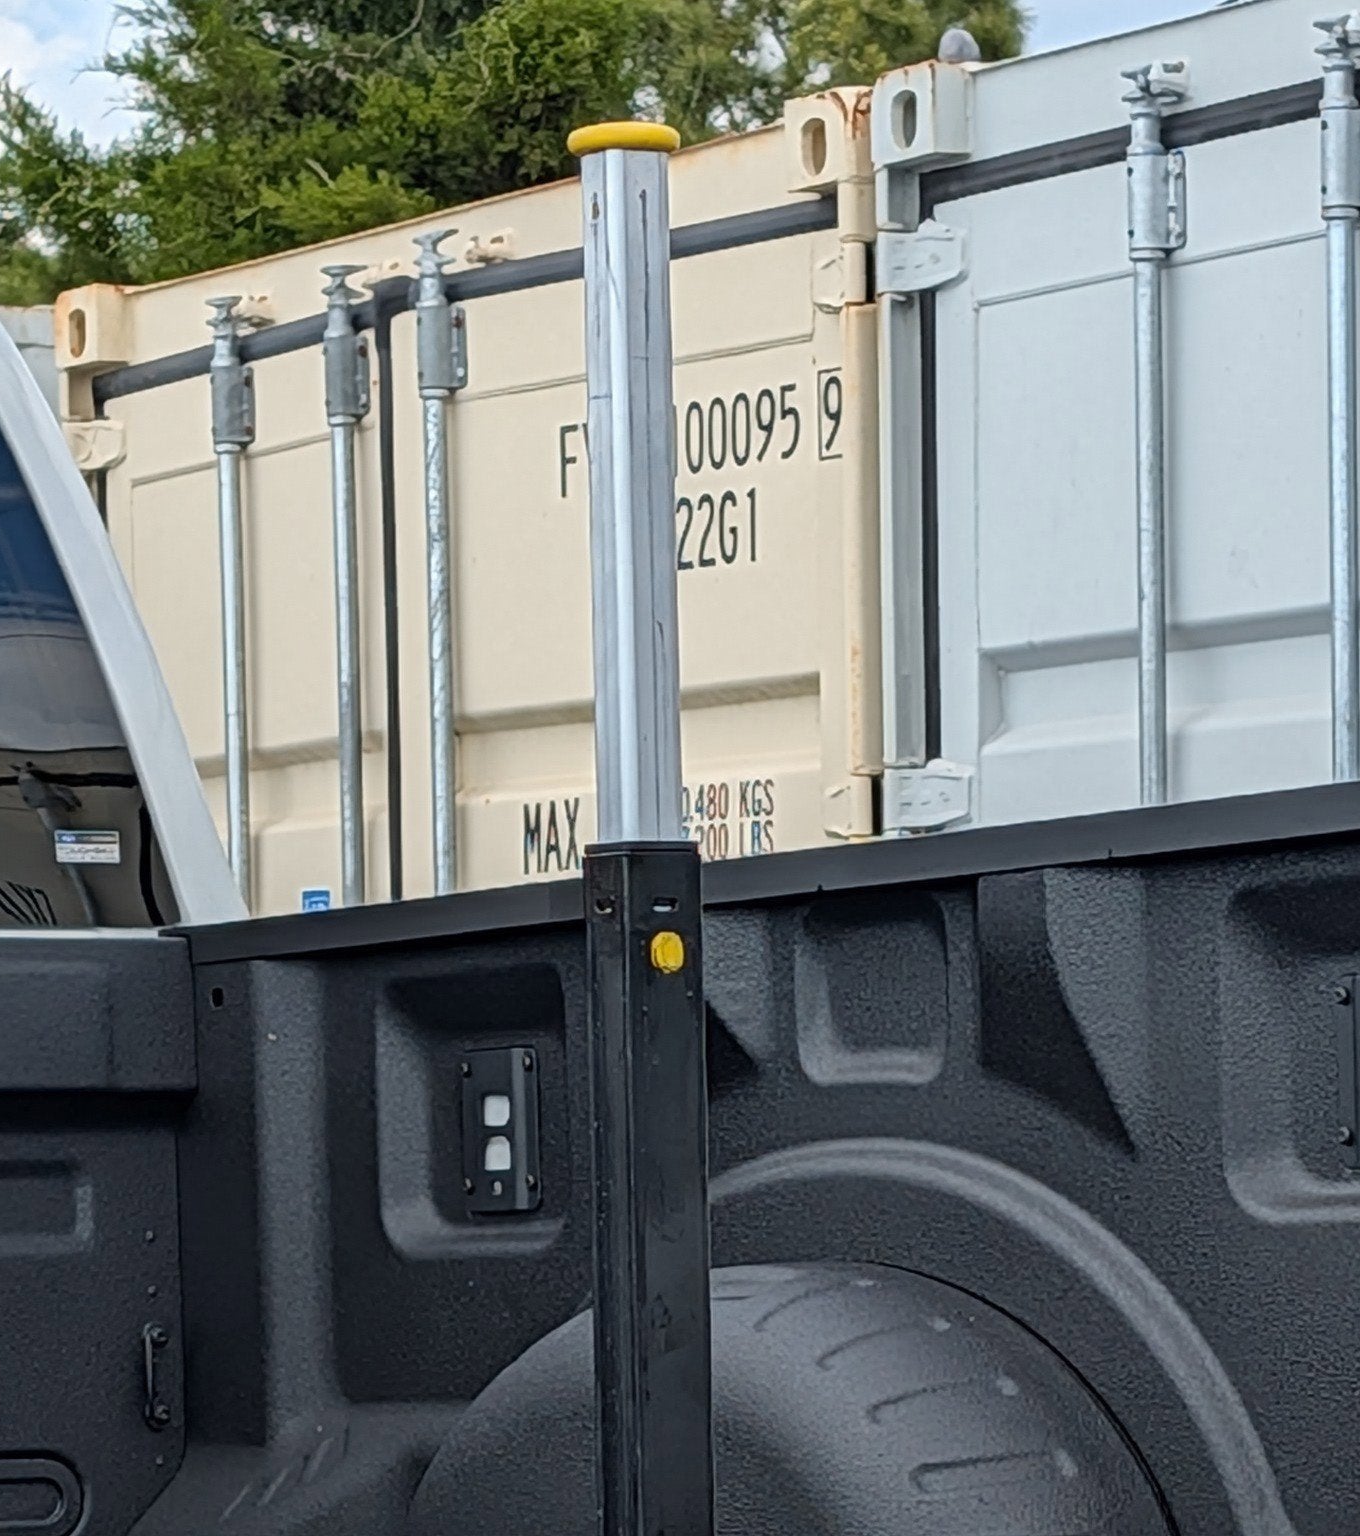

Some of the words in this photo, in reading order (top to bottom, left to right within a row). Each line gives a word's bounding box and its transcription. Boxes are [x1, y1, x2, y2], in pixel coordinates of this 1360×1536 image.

[823, 376, 843, 451] 9
[676, 486, 757, 571] 22G1
[523, 797, 580, 876] MAX
[739, 778, 775, 818] KGS
